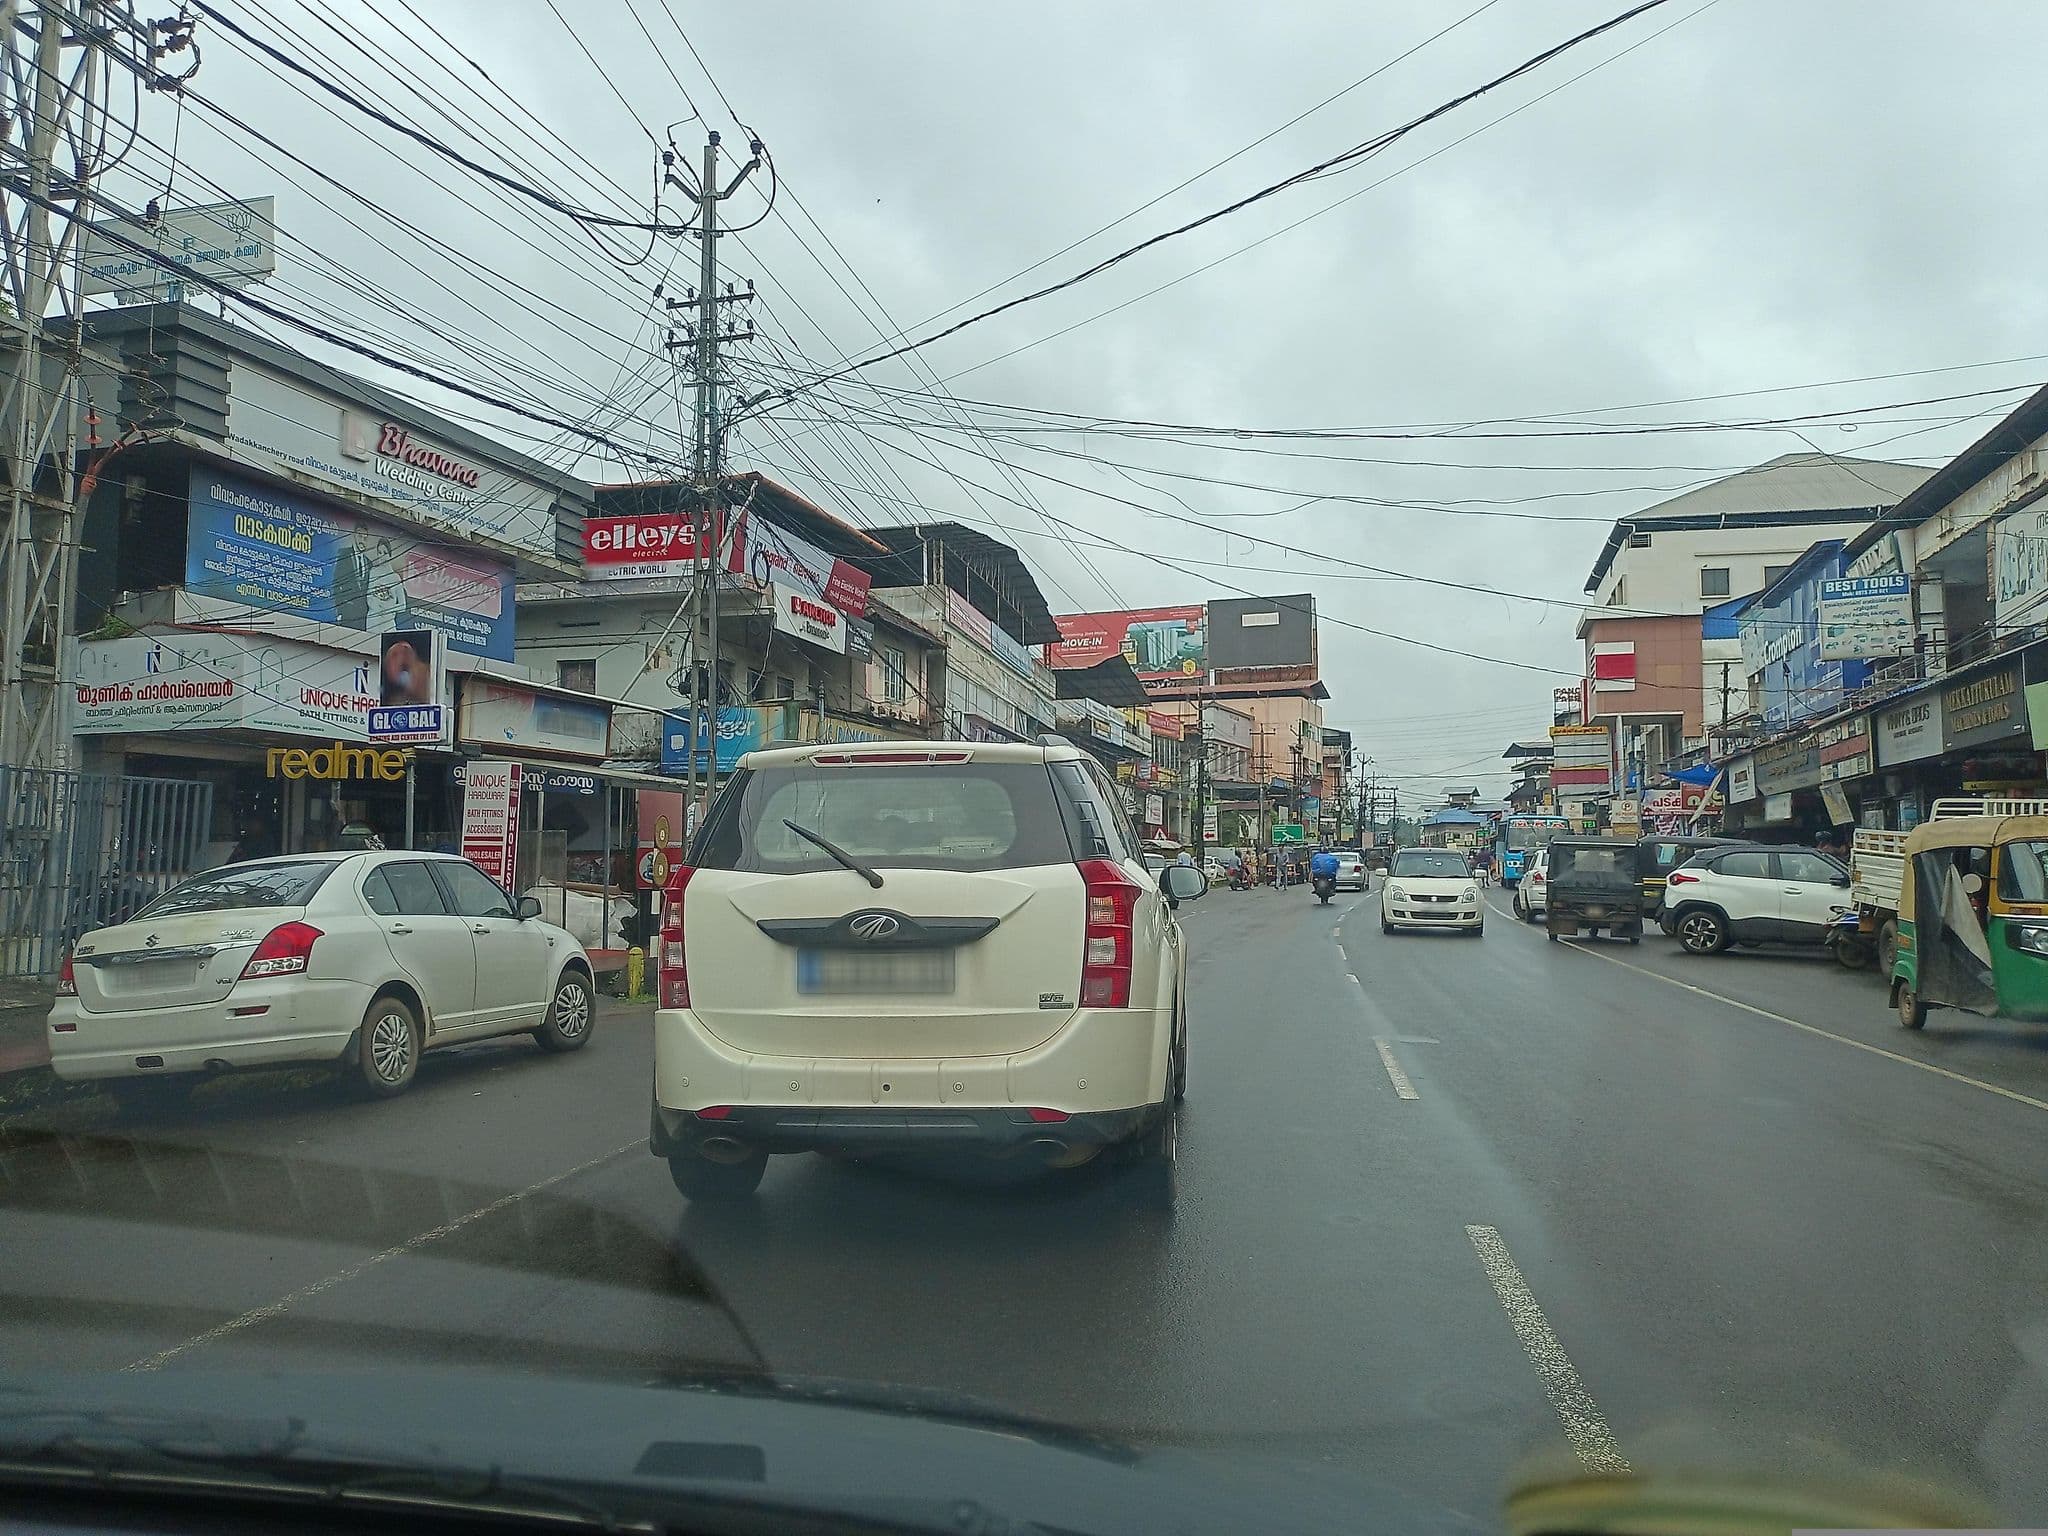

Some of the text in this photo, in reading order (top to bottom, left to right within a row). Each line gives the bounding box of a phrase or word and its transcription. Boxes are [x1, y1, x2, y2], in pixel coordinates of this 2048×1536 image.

[229, 432, 304, 466] Wadakkanchery road
[379, 422, 480, 488] Bhavana
[375, 457, 434, 497] Wedding
[437, 483, 478, 509] Centre
[591, 523, 696, 550] elleys
[639, 564, 667, 575] WORLD
[1825, 575, 1904, 593] BEST TOOLS
[1061, 637, 1102, 648] MOVE-IN
[1764, 626, 1802, 664] Crompton
[77, 682, 134, 707] യൂണിക്
[300, 687, 348, 710] UNIQUE
[156, 706, 162, 714] &
[299, 708, 321, 720] BATH
[322, 711, 358, 724] FITTINGS
[266, 741, 407, 780] realme
[469, 774, 506, 789] UNIQUE
[468, 790, 505, 801] HARDWARE
[467, 809, 504, 818] BATH FITTINGS
[466, 825, 502, 834] ACCESSORIES
[464, 851, 502, 860] WHOLESALER
